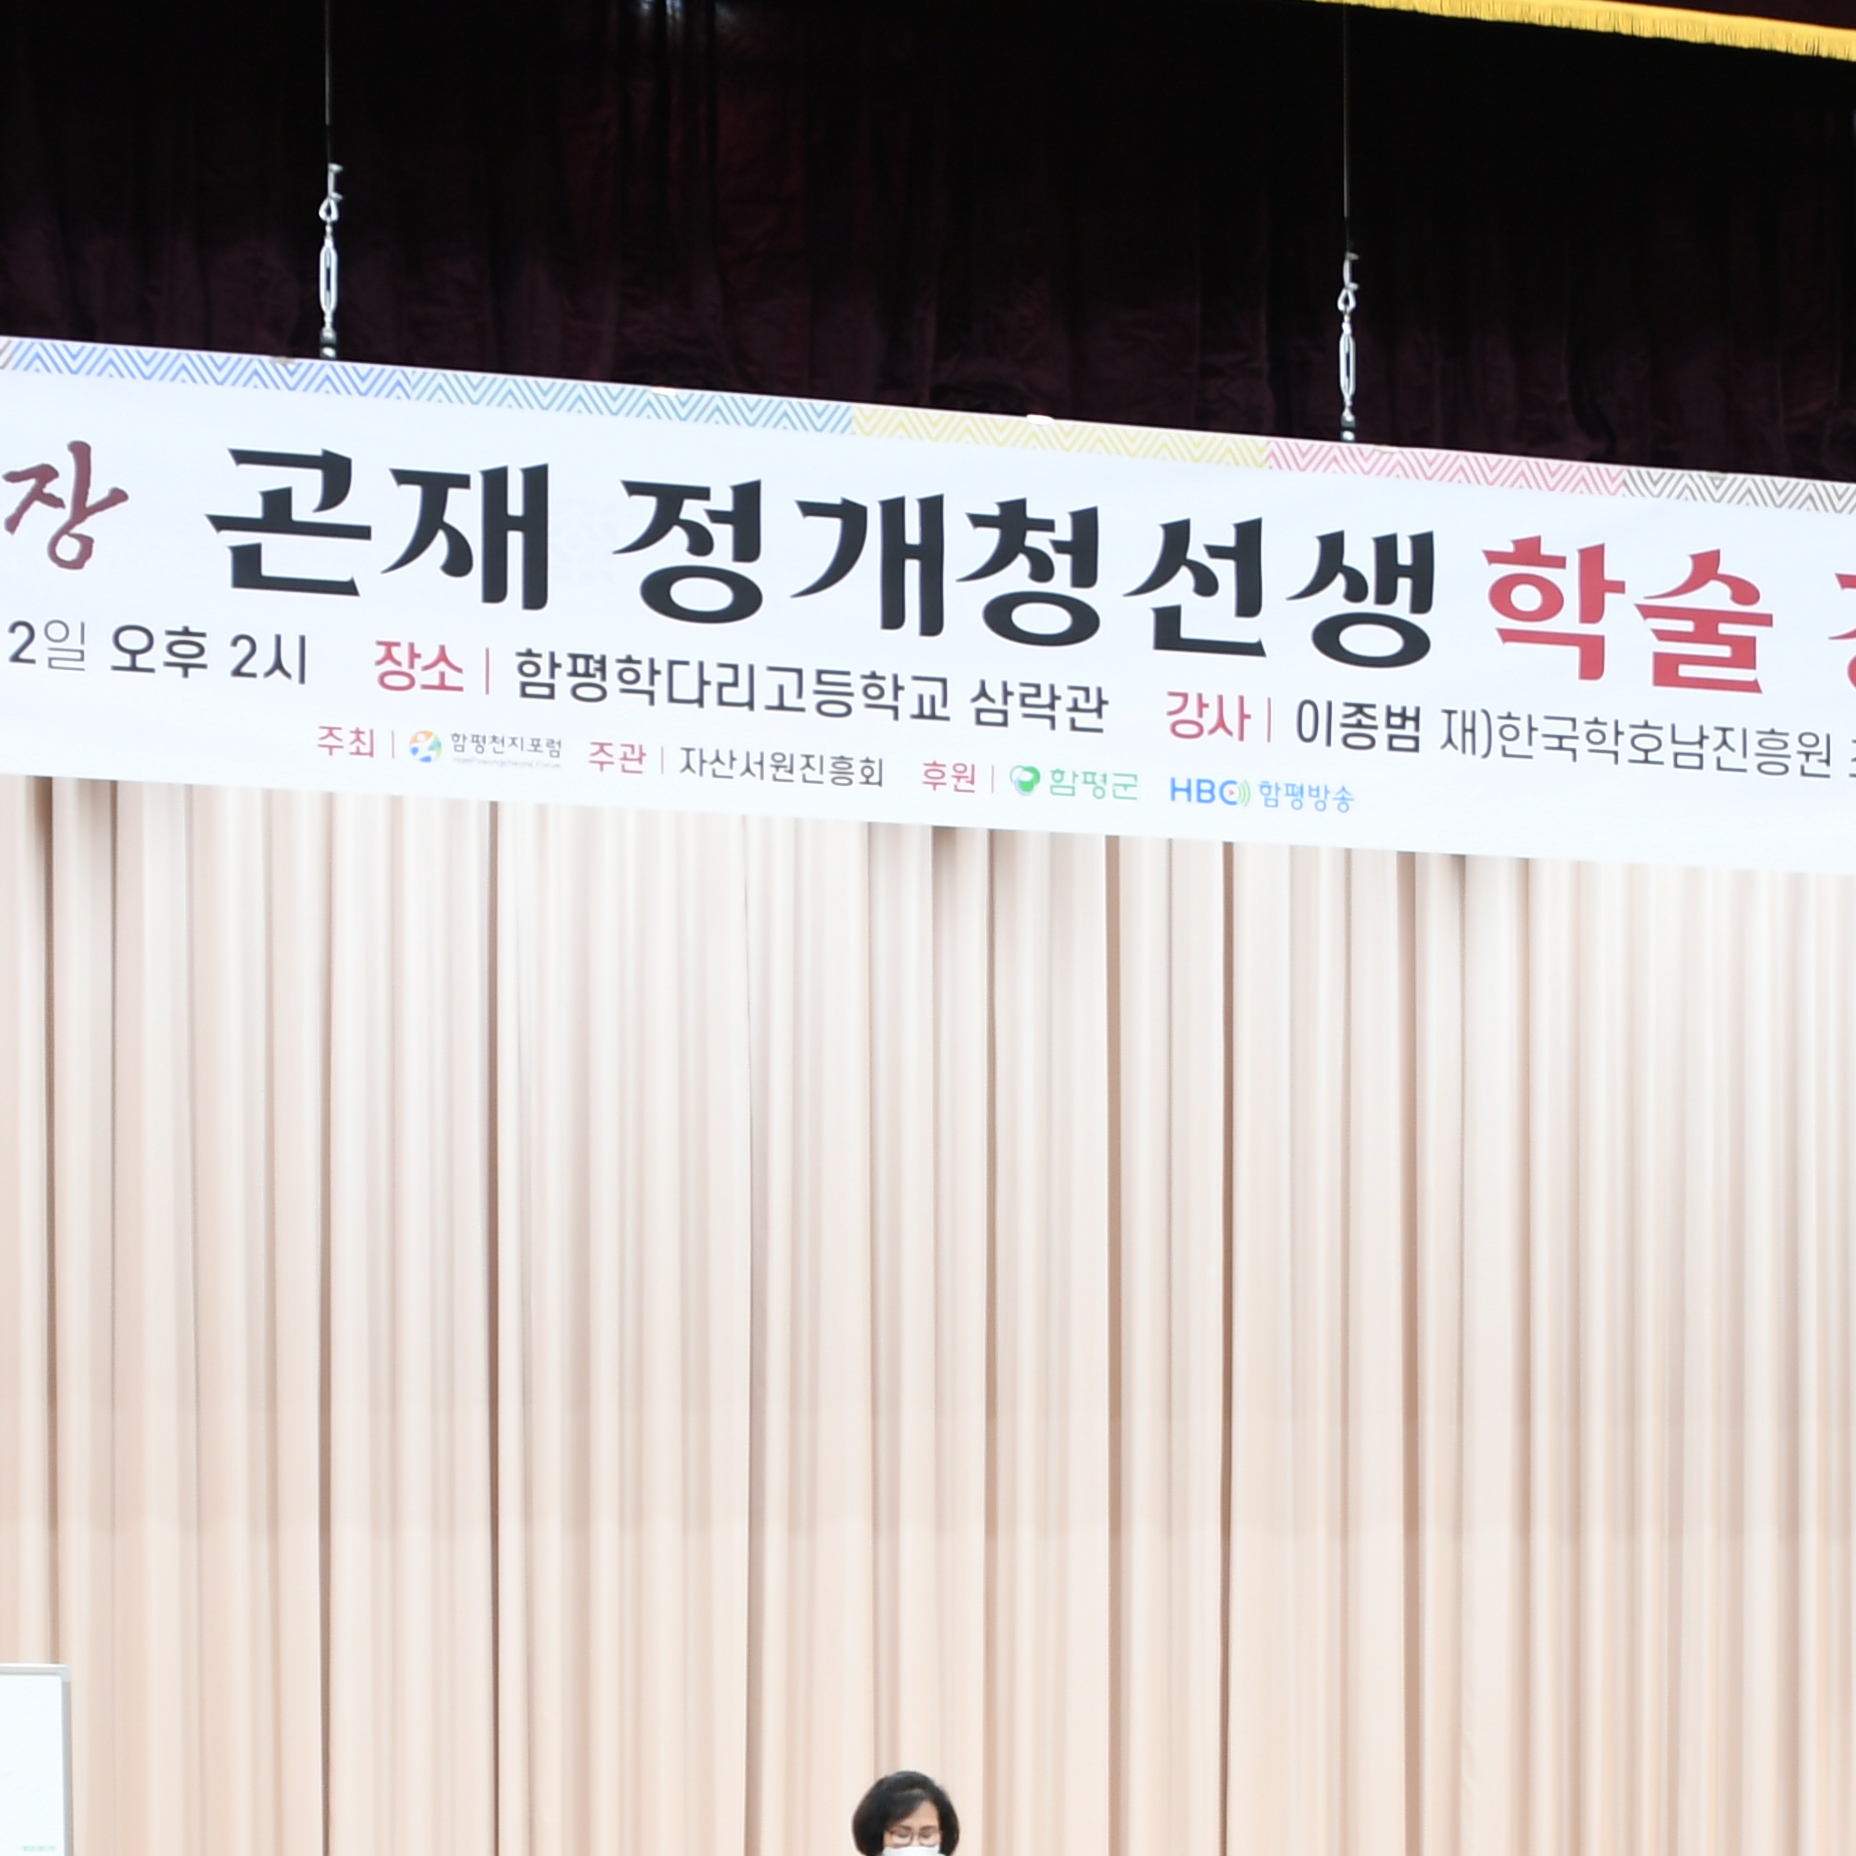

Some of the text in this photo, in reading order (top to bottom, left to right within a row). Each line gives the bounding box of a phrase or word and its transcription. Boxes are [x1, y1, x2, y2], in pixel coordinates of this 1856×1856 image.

[205, 448, 549, 611] 곤재
[612, 479, 1436, 669] 정개청선생
[1482, 535, 1774, 694] 학술
[8, 619, 85, 672] 2일
[110, 624, 208, 679] 오후
[230, 633, 306, 685] 2시
[374, 640, 464, 692] 장소
[515, 647, 951, 722] 함평학다리고등학교
[970, 679, 1110, 734] 삼락관
[1166, 691, 1252, 742] 강사
[1296, 698, 1421, 753] 이종범
[1440, 708, 1831, 779] 재)한국학호남진흥원
[317, 725, 1355, 814] 주최 함평천지포럼 주관 자산서원진흥회 후원 함평군 HBC 함평방송
